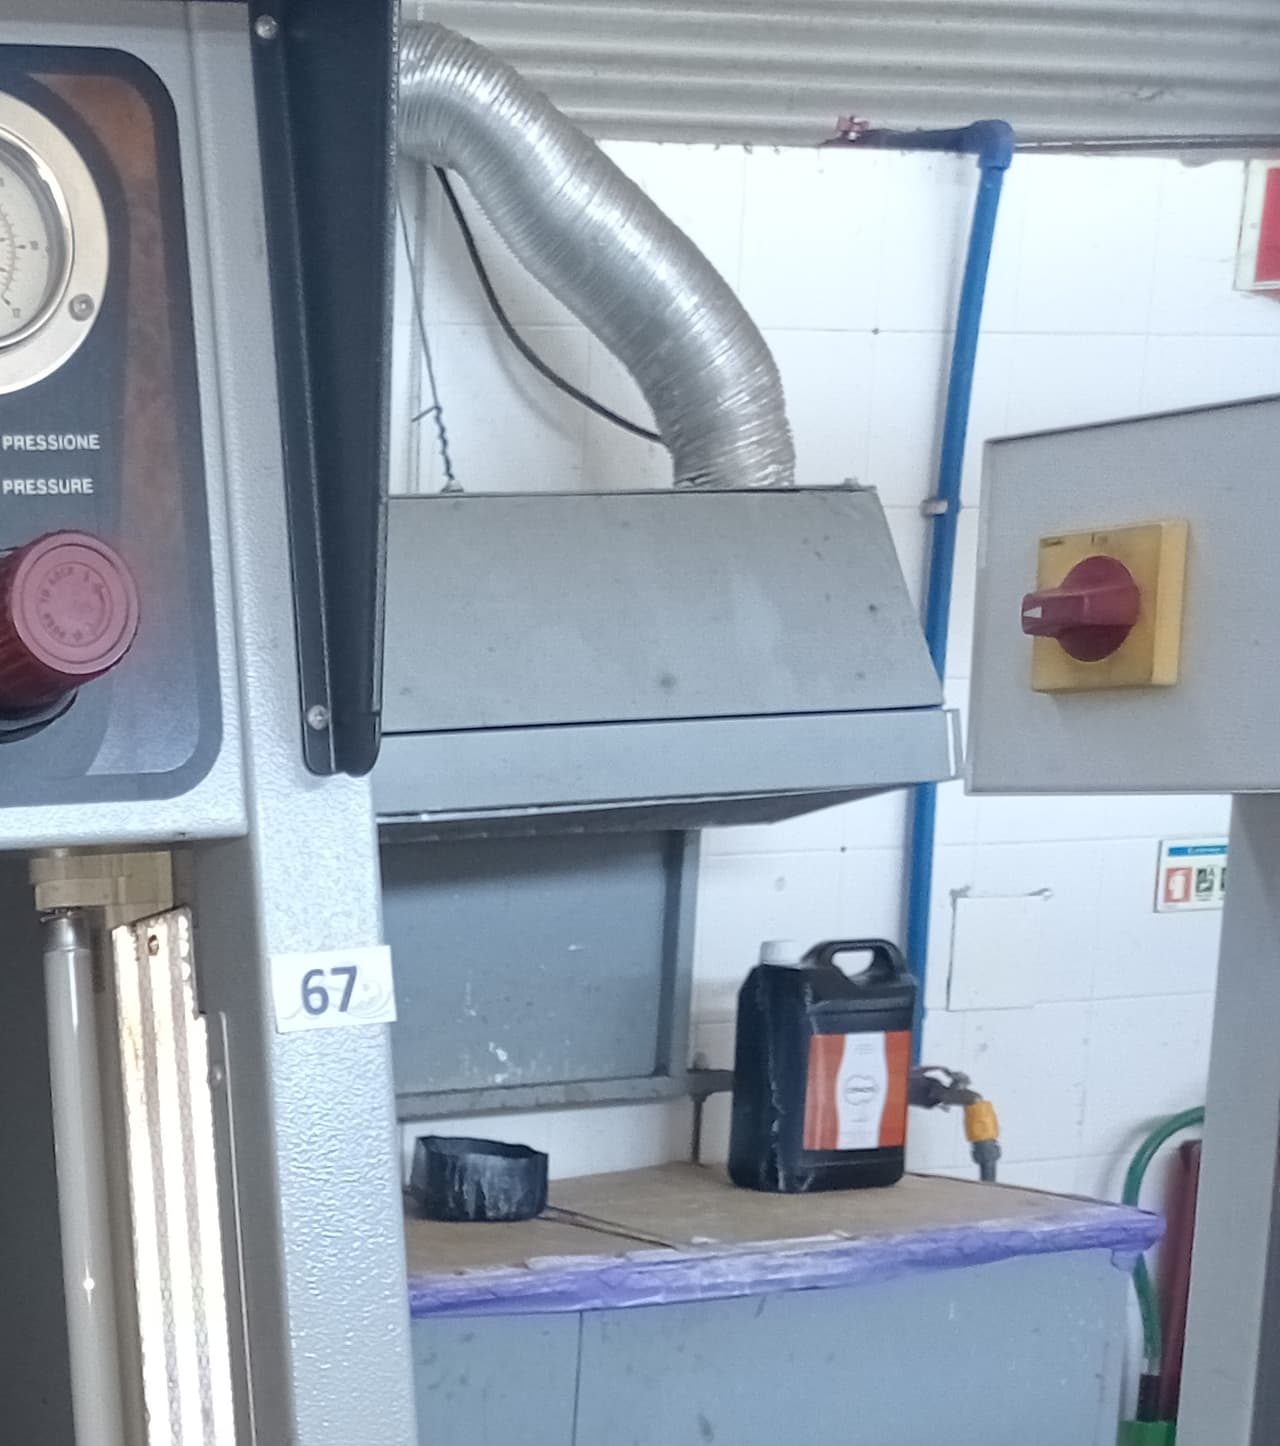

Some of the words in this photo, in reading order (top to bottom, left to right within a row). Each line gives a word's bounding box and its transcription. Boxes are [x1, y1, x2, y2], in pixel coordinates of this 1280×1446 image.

[2, 434, 101, 450] PRESSIONE
[2, 478, 95, 495] PRESSURE
[301, 965, 357, 1015] 67
